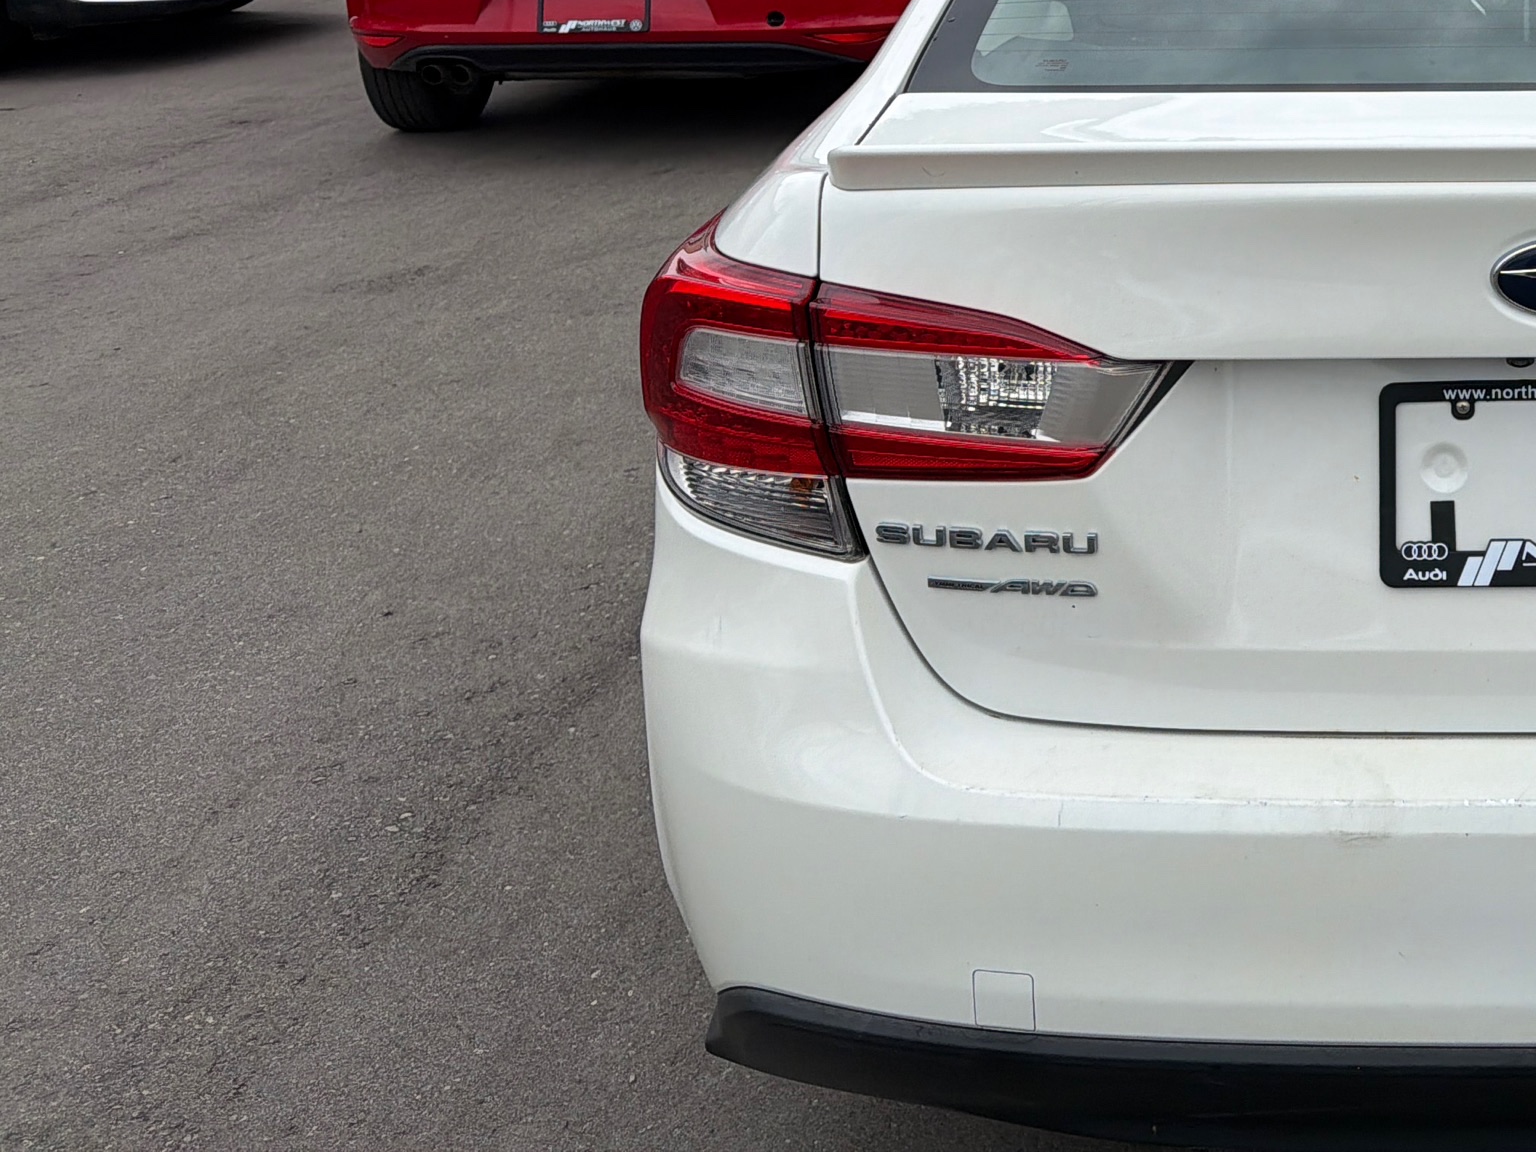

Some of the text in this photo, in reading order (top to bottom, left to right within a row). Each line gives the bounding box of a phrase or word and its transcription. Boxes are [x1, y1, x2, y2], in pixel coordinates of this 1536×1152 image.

[875, 521, 1099, 555] SUBARU
[1402, 567, 1447, 581] Audi
[989, 577, 1099, 597] AWD
